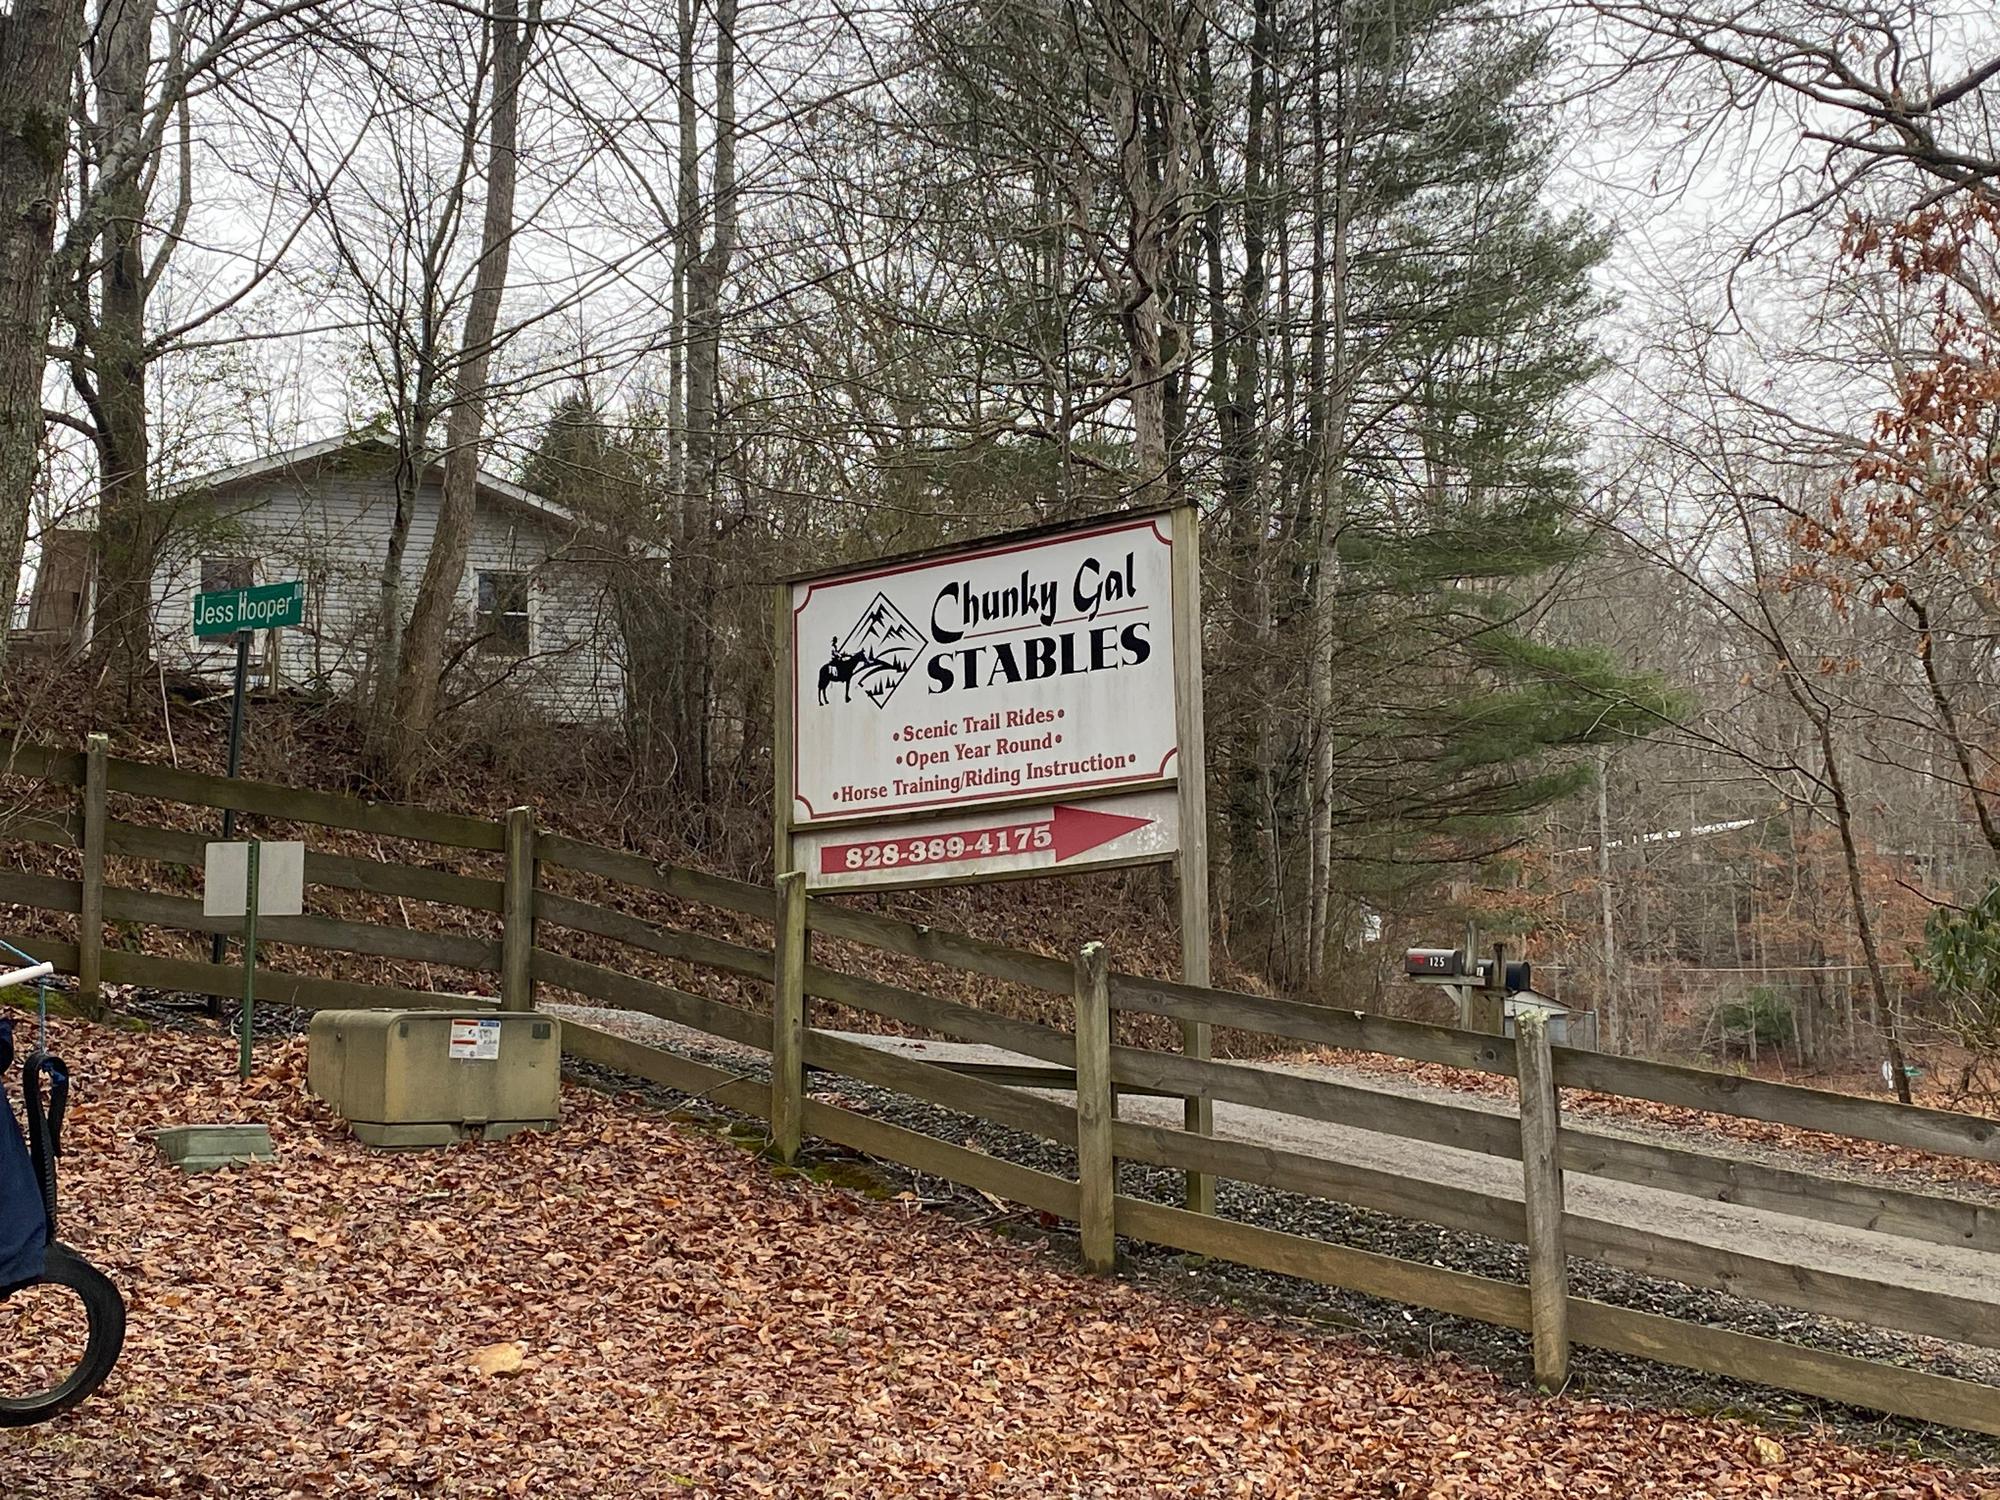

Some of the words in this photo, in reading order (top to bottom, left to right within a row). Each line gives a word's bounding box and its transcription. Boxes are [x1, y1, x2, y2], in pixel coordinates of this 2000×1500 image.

[195, 595, 234, 625] Jess
[237, 590, 293, 624] Hooper
[930, 570, 1058, 644] Chunky
[1072, 552, 1137, 621] Gal
[927, 621, 1152, 695] STABLES
[903, 719, 958, 742] Scenic
[962, 713, 1001, 733] Trail
[1006, 708, 1055, 728] Rides
[906, 750, 950, 770] Open
[954, 742, 991, 761] Year
[996, 732, 1053, 755] Round
[841, 785, 888, 803] Horse
[892, 767, 1021, 793] Training/Riding
[1026, 753, 1126, 780] Instruction
[844, 823, 1053, 869] 828-389-4175
[1429, 956, 1445, 967] 125
